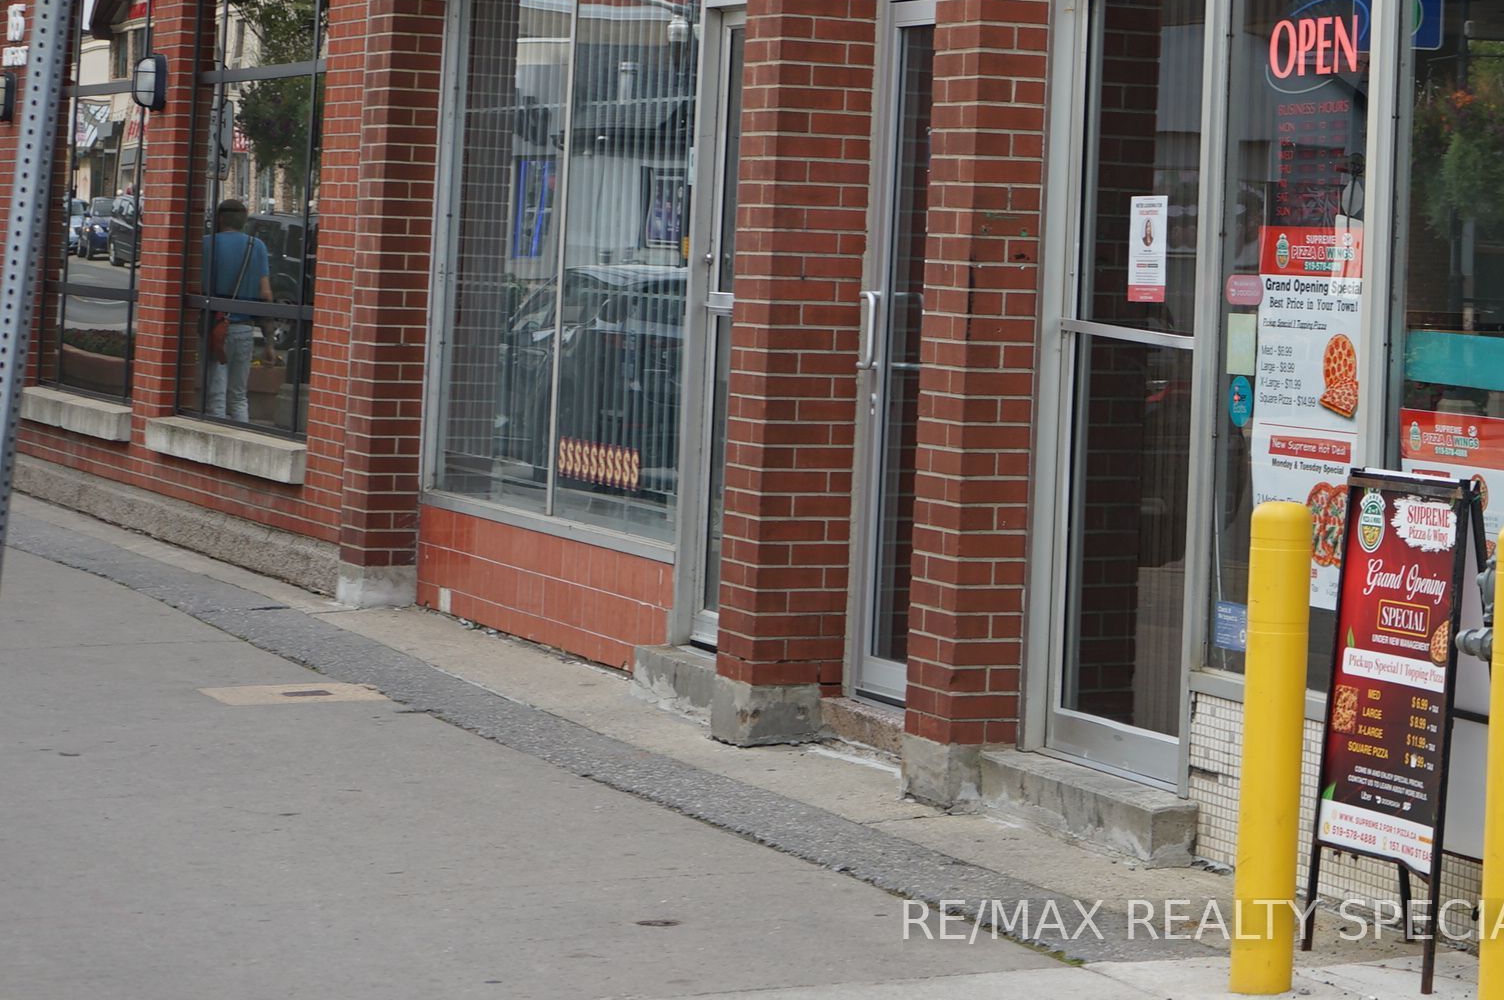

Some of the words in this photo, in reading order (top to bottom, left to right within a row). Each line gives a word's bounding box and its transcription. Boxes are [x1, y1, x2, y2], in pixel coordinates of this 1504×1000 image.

[1269, 15, 1358, 79] OPEN
[1278, 102, 1316, 116] BUSINESS
[1318, 100, 1349, 113] HOURS
[1291, 245, 1317, 259] PIZZA
[1265, 278, 1291, 291] Grand
[1294, 279, 1329, 296] Opening
[1331, 280, 1362, 296] Special
[1270, 297, 1284, 308] Best
[1286, 297, 1304, 309] Price
[1307, 298, 1314, 309] in
[1317, 299, 1334, 311] Your
[1337, 300, 1358, 312] Town!
[1288, 440, 1317, 455] Supreme
[1422, 432, 1445, 446] PIZZA
[1453, 435, 1479, 450] WINGS
[1272, 457, 1293, 470] Monday
[1299, 461, 1322, 473] Tuesday
[1323, 464, 1344, 475] Special
[1407, 504, 1450, 528] SUPREME
[1409, 526, 1426, 540] Pizza
[1433, 529, 1448, 547] Wing
[1363, 558, 1405, 596] Grand
[1406, 564, 1446, 605] Opening
[1381, 605, 1425, 632] SPECIAL
[1372, 634, 1388, 644] UNDER
[1389, 637, 1399, 646] NEW
[1400, 639, 1430, 651] MANAGEMENT
[1349, 653, 1373, 673] Pickup
[1375, 658, 1399, 675] Special
[1404, 664, 1428, 684] Topping
[1430, 669, 1443, 684] Pizza
[1368, 688, 1381, 700] MED
[1362, 706, 1382, 719] LARGE
[1358, 724, 1383, 738] X-LARGE
[1348, 741, 1372, 755] SQUARE
[1372, 746, 1389, 759] PIZZA
[1356, 816, 1378, 829] SUPREME
[1332, 825, 1376, 845] 519-578-4888
[1402, 844, 1414, 856] KING
[1415, 847, 1422, 858] ST
